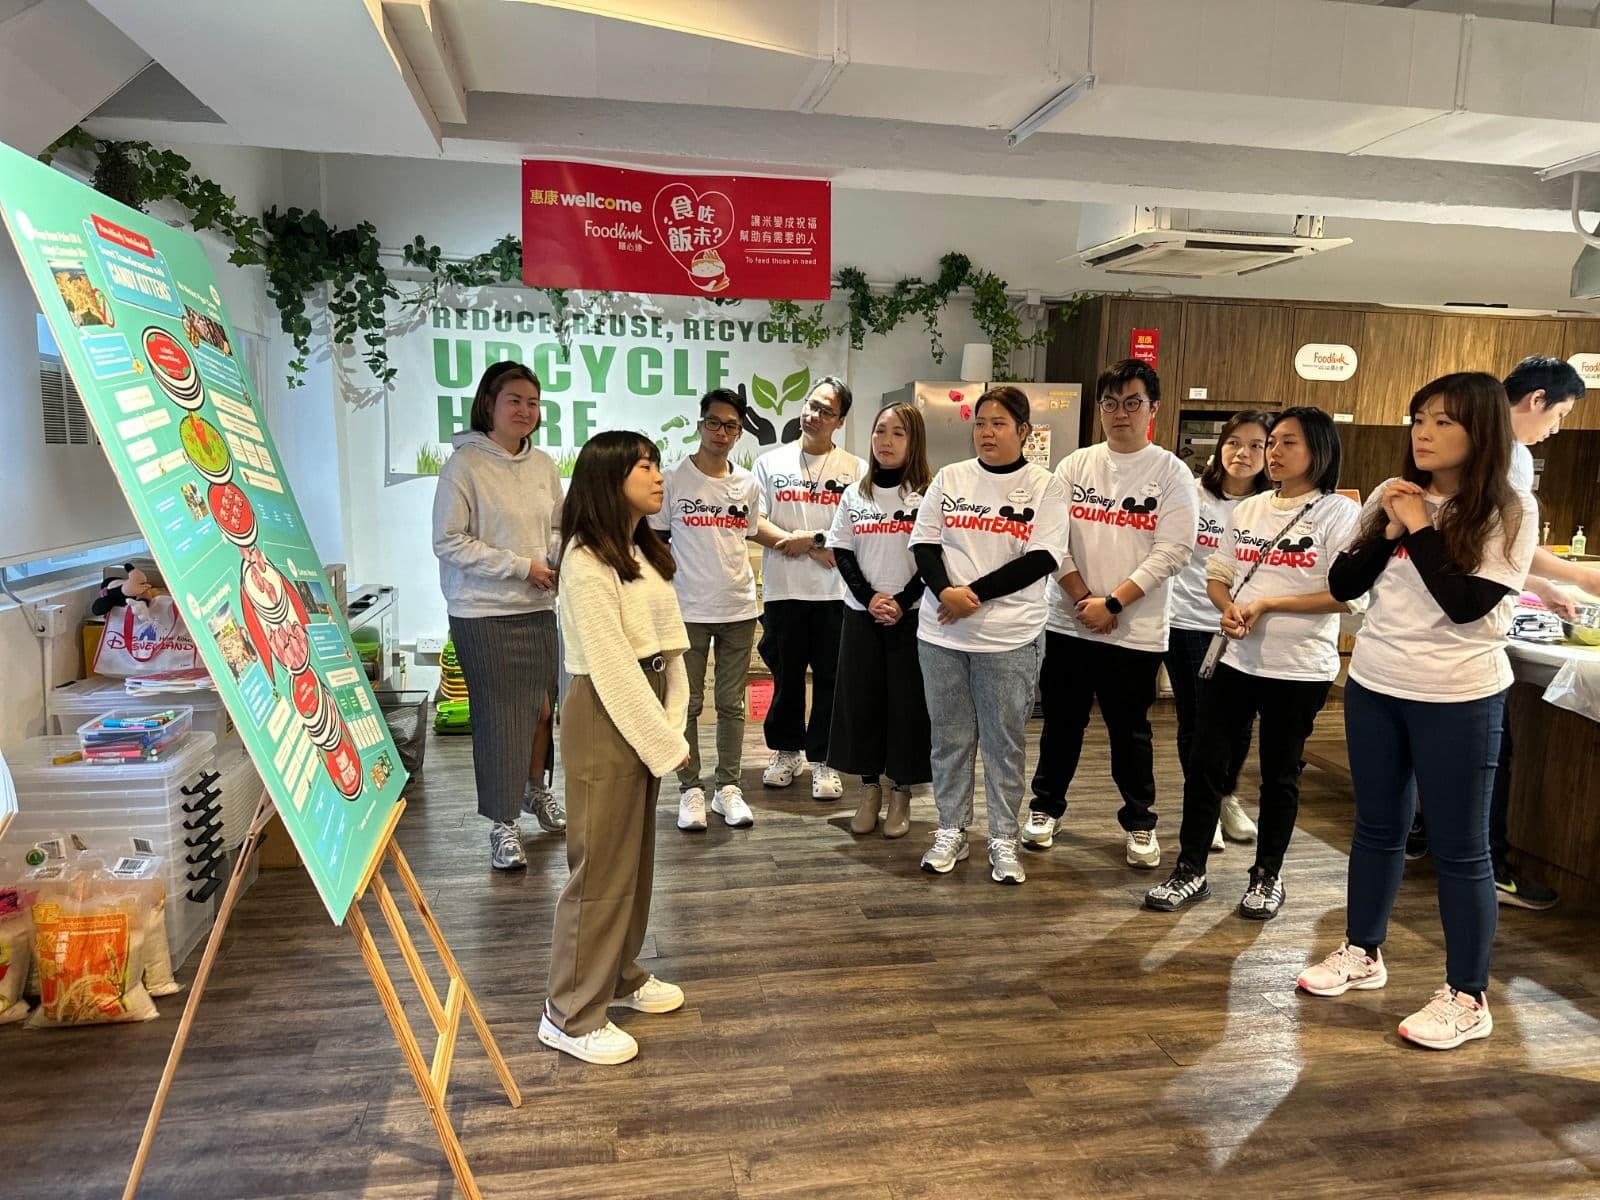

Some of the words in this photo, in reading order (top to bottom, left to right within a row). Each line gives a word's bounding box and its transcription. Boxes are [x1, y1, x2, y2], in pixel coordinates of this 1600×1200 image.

[529, 189, 559, 206] 惠康
[560, 192, 642, 213] wellcome
[751, 214, 817, 230] 讓米變成祝福
[585, 219, 653, 245] Foodlink
[740, 230, 817, 244] 幫助有需要的人
[745, 256, 754, 264] To
[755, 257, 770, 265] feed
[573, 313, 674, 343] REUSE,
[683, 319, 803, 343] RECYCLE
[1313, 351, 1350, 366] Foodlink
[437, 396, 597, 447] HRE
[775, 490, 842, 506] VOLUNTEA
[941, 492, 991, 518] Disney
[1071, 483, 1116, 512] Disney
[677, 498, 723, 518] Disney
[847, 509, 888, 523] Disney
[1198, 516, 1224, 534] Disn
